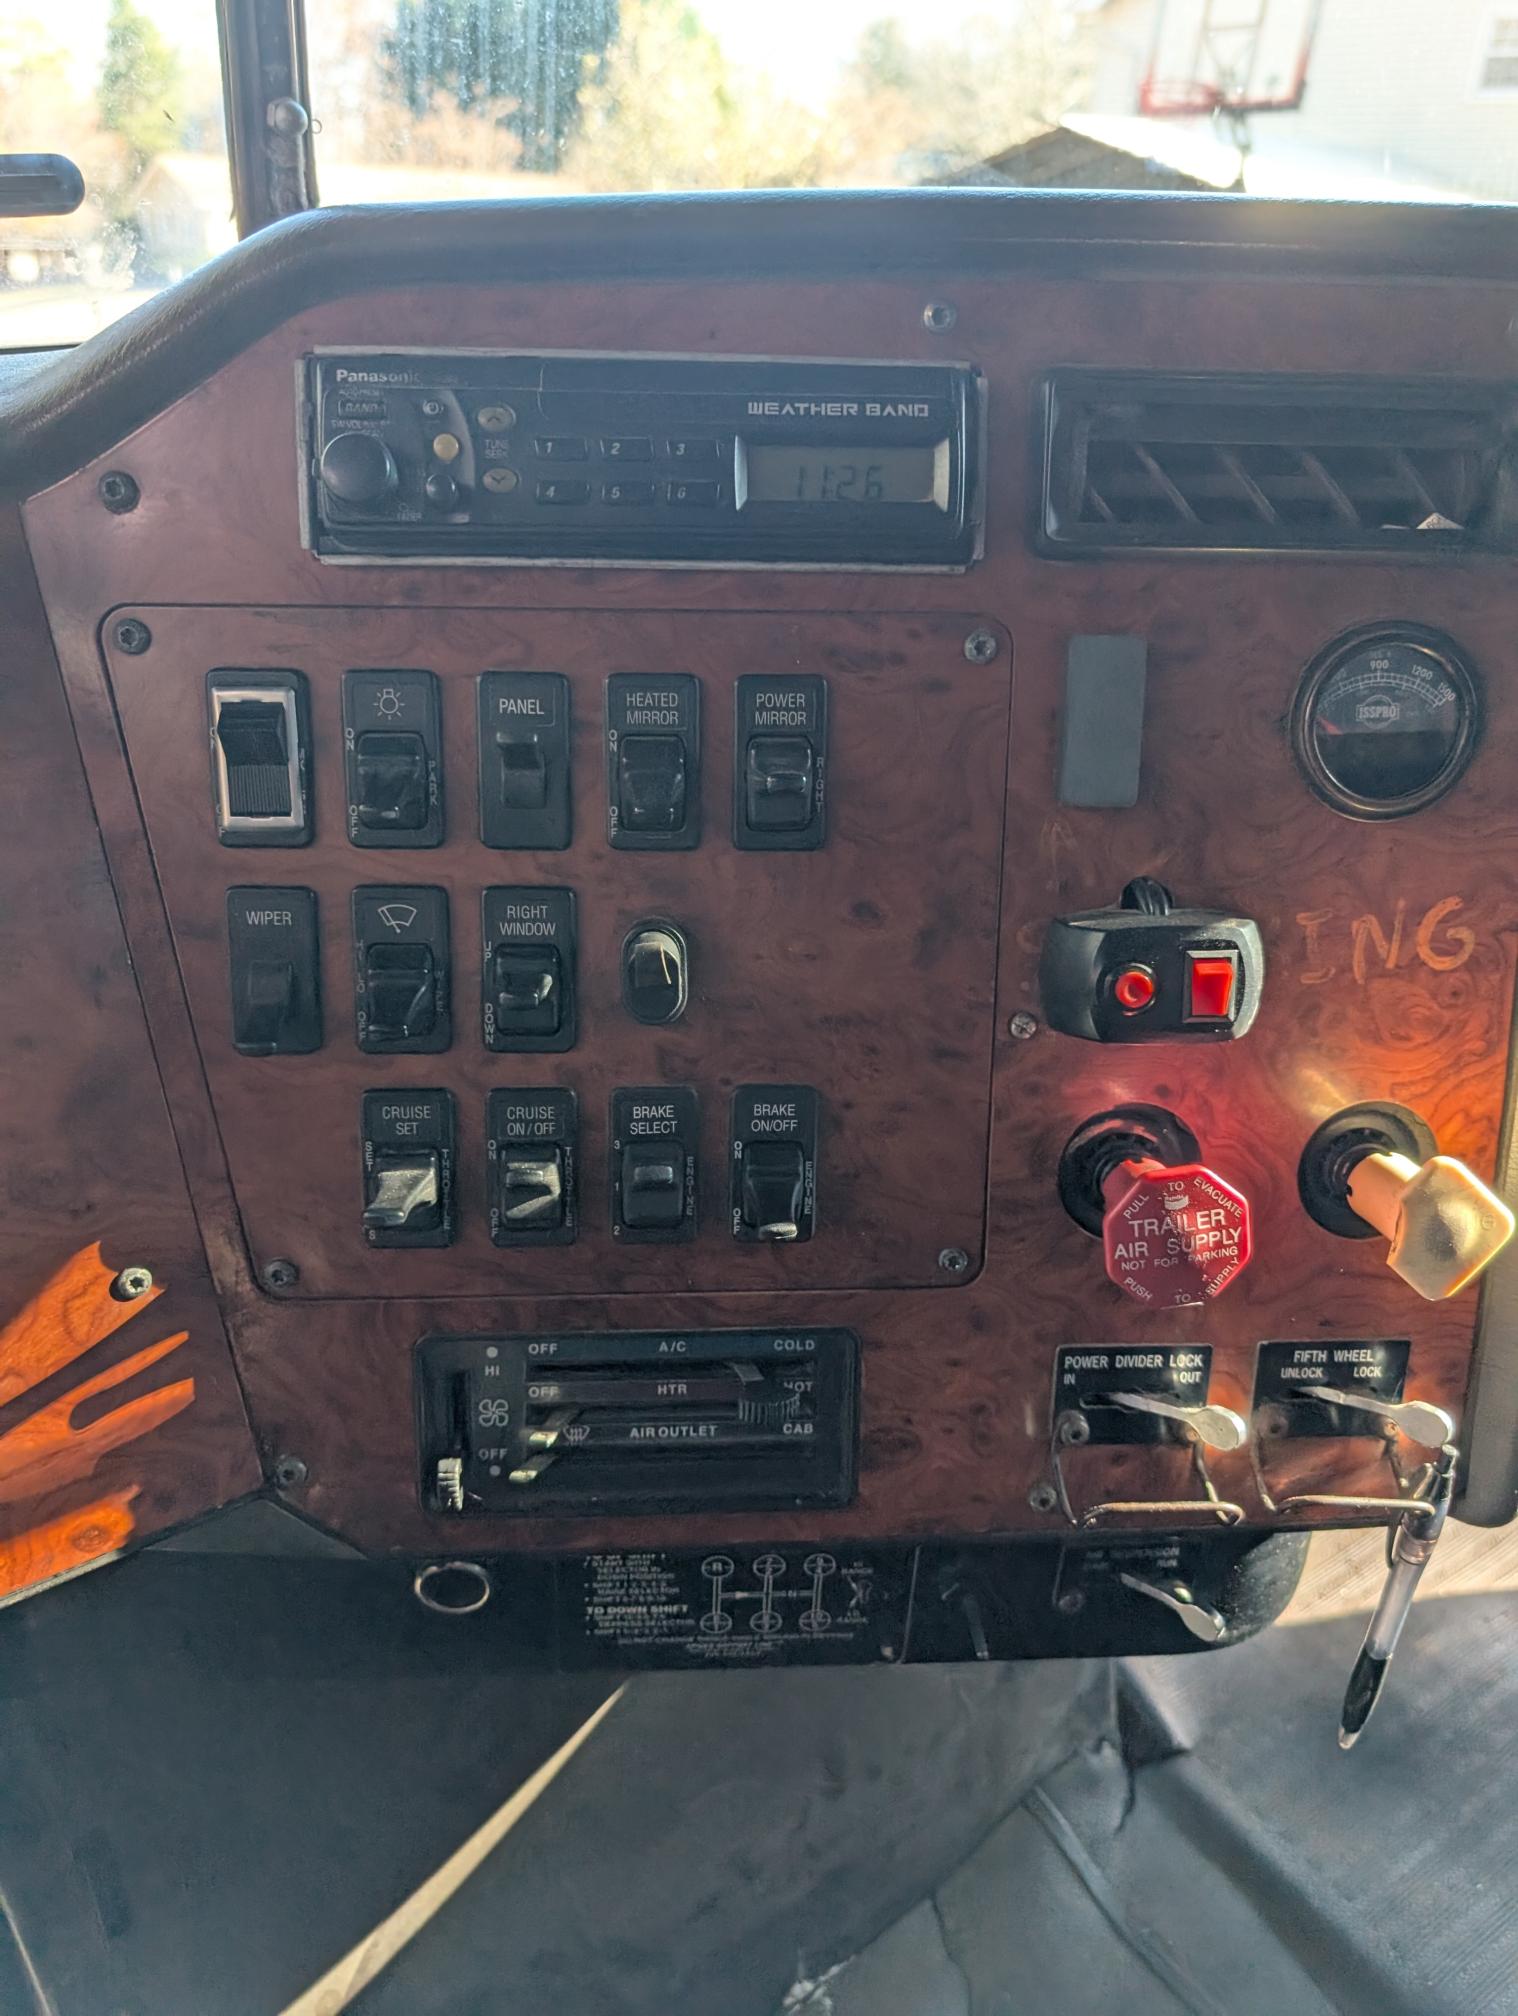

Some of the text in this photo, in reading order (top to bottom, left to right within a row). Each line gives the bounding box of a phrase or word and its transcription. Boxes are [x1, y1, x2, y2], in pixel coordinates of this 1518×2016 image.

[336, 369, 420, 384] Panasonic
[748, 402, 929, 417] WEATHER BAND
[545, 442, 552, 453] 1
[610, 442, 620, 454] 2
[676, 443, 685, 455] 3
[546, 487, 555, 497] 4
[611, 487, 620, 498] 5
[677, 487, 686, 498] 6
[1370, 659, 1389, 670] 900
[1412, 664, 1433, 681] 1200
[1438, 682, 1456, 701] 1500
[499, 698, 544, 715] PANEL
[626, 693, 678, 707] HEATED
[756, 693, 805, 708] POWER
[626, 711, 679, 725] MIRROR
[755, 711, 806, 725] MIRROR
[346, 728, 354, 751] ON
[608, 730, 618, 752] ON
[428, 761, 437, 805] PARK
[349, 805, 359, 837] OFF
[609, 806, 618, 838] OFF
[246, 911, 292, 925] WIPER
[507, 905, 548, 919] RIGHT
[499, 922, 556, 936] WINDOW
[484, 1003, 496, 1044] DOWN
[382, 1106, 431, 1119] CRUISE
[507, 1106, 554, 1119] CRUISE
[633, 1105, 674, 1119] BRAKE
[753, 1104, 796, 1117] BRAKE
[395, 1122, 419, 1135] SET
[630, 1121, 677, 1135] SELECT
[751, 1119, 798, 1132] ON/OFF
[488, 1140, 497, 1160] ON
[614, 1140, 621, 1150] 3
[734, 1141, 742, 1159] ON
[365, 1141, 374, 1171] SET
[686, 1157, 694, 1216] ENGINE
[805, 1161, 813, 1215] ENGINE
[1123, 1177, 1243, 1219] PULL TO EVACUATE
[733, 1208, 741, 1234] OFF
[1129, 1208, 1226, 1237] TRAILER
[613, 1226, 621, 1235] 2
[1114, 1227, 1242, 1259] AIR SUPPLY
[1121, 1246, 1238, 1271] NOT FOR PARKING
[1124, 1258, 1240, 1303] PUSH TO SUPPLY
[528, 1343, 558, 1355] OFF
[659, 1341, 687, 1352] A/C
[774, 1339, 815, 1351] COLD
[1065, 1353, 1203, 1369] POWER DIVIDER LOCK
[1294, 1349, 1374, 1363] FIFTH WHEEL
[485, 1365, 500, 1376] HI
[1179, 1371, 1202, 1383] OUT
[1281, 1367, 1323, 1379] UNLOCK
[1353, 1366, 1382, 1378] LOCK
[1064, 1373, 1075, 1385] IN
[528, 1386, 559, 1398] OFF
[657, 1384, 687, 1395] HTR
[658, 1425, 718, 1437] OUTLET
[783, 1423, 813, 1435] CAB
[478, 1448, 508, 1460] OFF
[607, 1605, 648, 1614] DOWN
[650, 1604, 689, 1613] SHIFT
